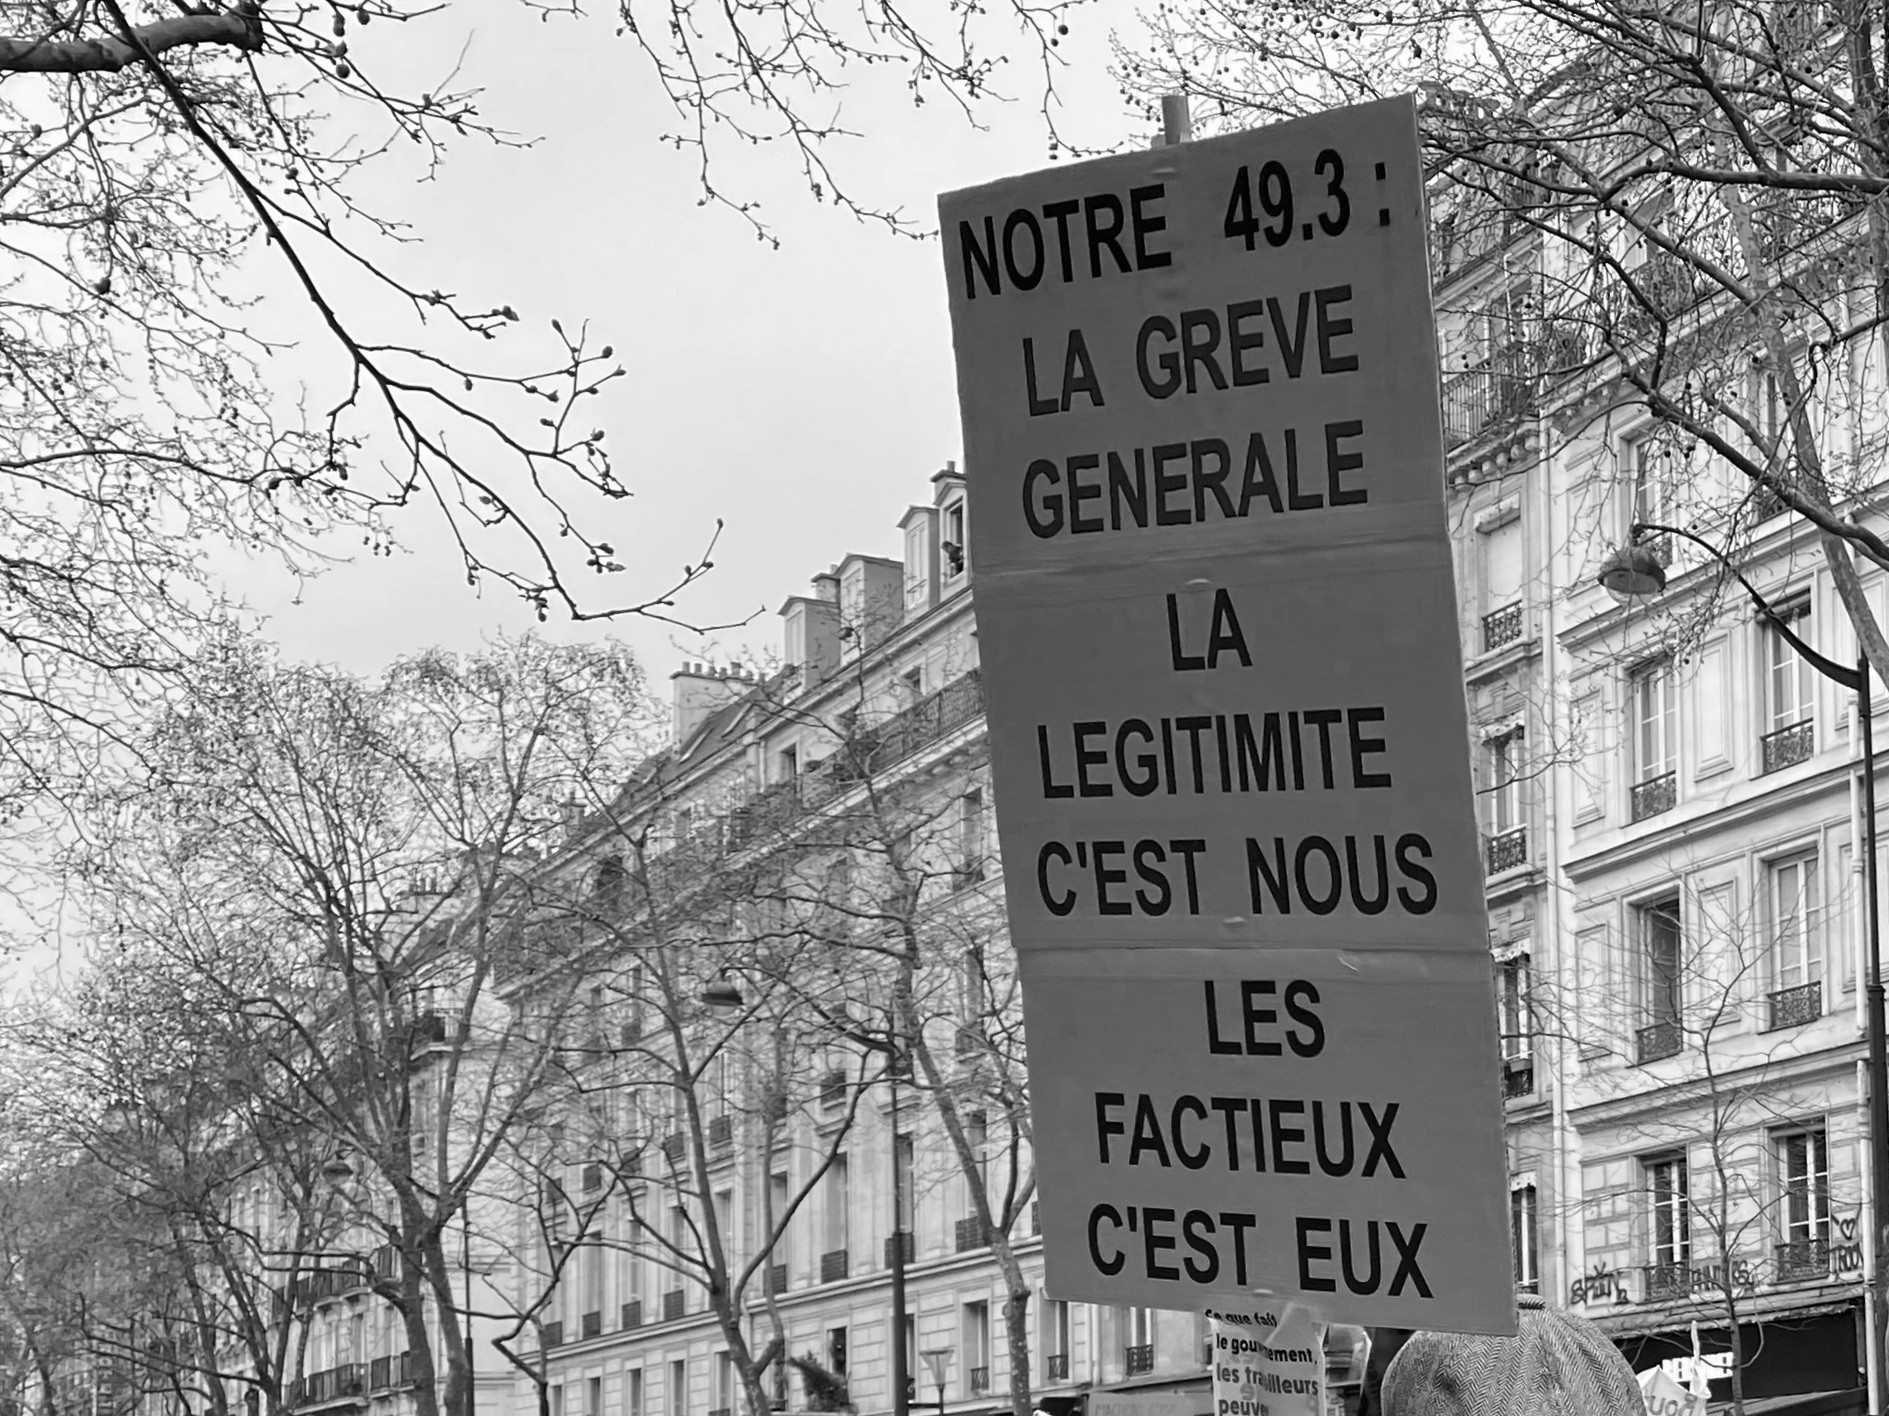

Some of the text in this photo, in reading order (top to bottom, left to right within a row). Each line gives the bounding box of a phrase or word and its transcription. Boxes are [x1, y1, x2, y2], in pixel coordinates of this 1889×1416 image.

[959, 185, 1172, 300] NOTRE
[1224, 148, 1350, 251] 49.3
[1023, 285, 1358, 416] LA GREVE
[1022, 420, 1367, 538] GENERALE
[1166, 588, 1252, 672] LA
[1037, 707, 1391, 798] LEGITIMITE
[1038, 833, 1438, 916] C'EST NOUS
[1203, 980, 1325, 1057] LES
[1094, 1092, 1406, 1179] FACTIEUX
[1088, 1204, 1434, 1299] C'EST EUX
[1216, 1333, 1228, 1350] le
[1226, 1313, 1252, 1325] que
[1254, 1311, 1278, 1328] fait
[1216, 1362, 1240, 1383] les
